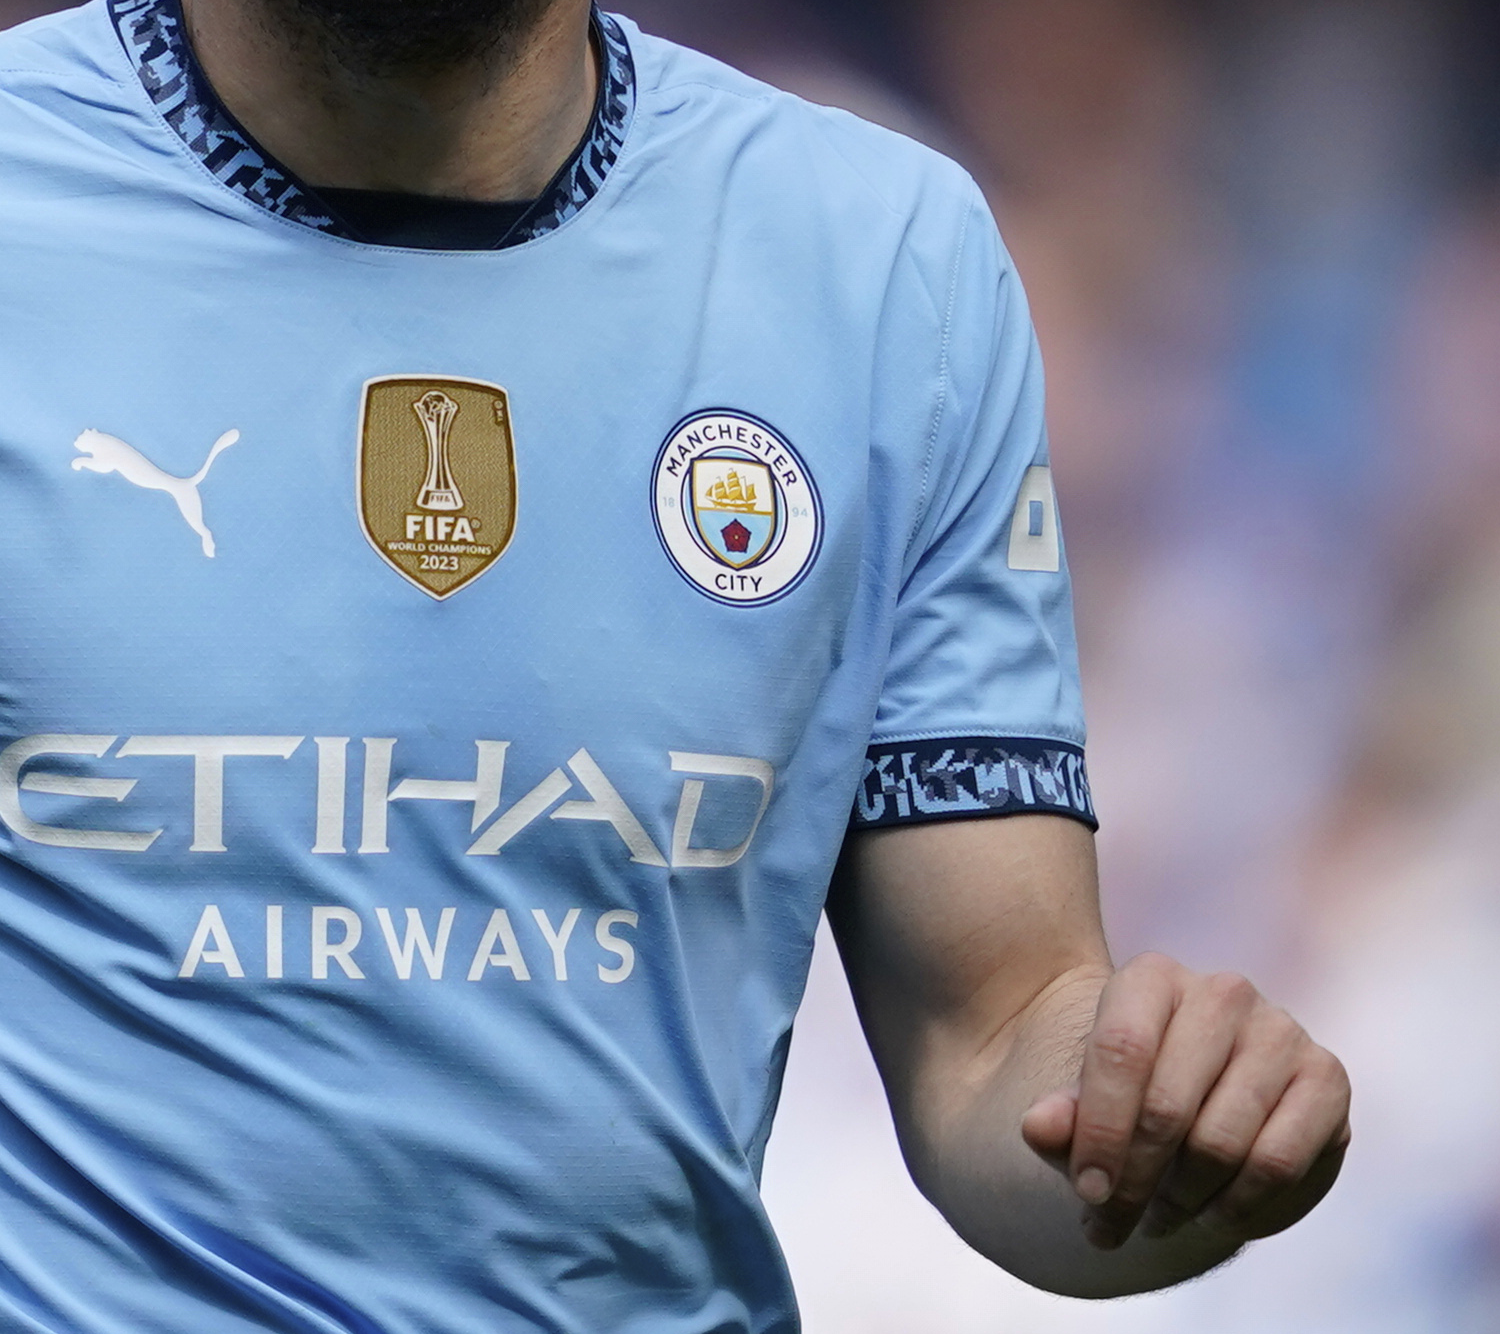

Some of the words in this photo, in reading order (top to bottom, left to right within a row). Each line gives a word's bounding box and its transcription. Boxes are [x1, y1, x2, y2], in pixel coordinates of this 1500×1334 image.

[666, 423, 798, 487] MANCHESTER
[662, 496, 676, 508] 18
[387, 542, 425, 552] WORLD
[428, 544, 491, 555] CHAMPIONS
[420, 555, 458, 570] 2023
[714, 573, 763, 593] CITY
[177, 904, 639, 985] AIRWAYS
